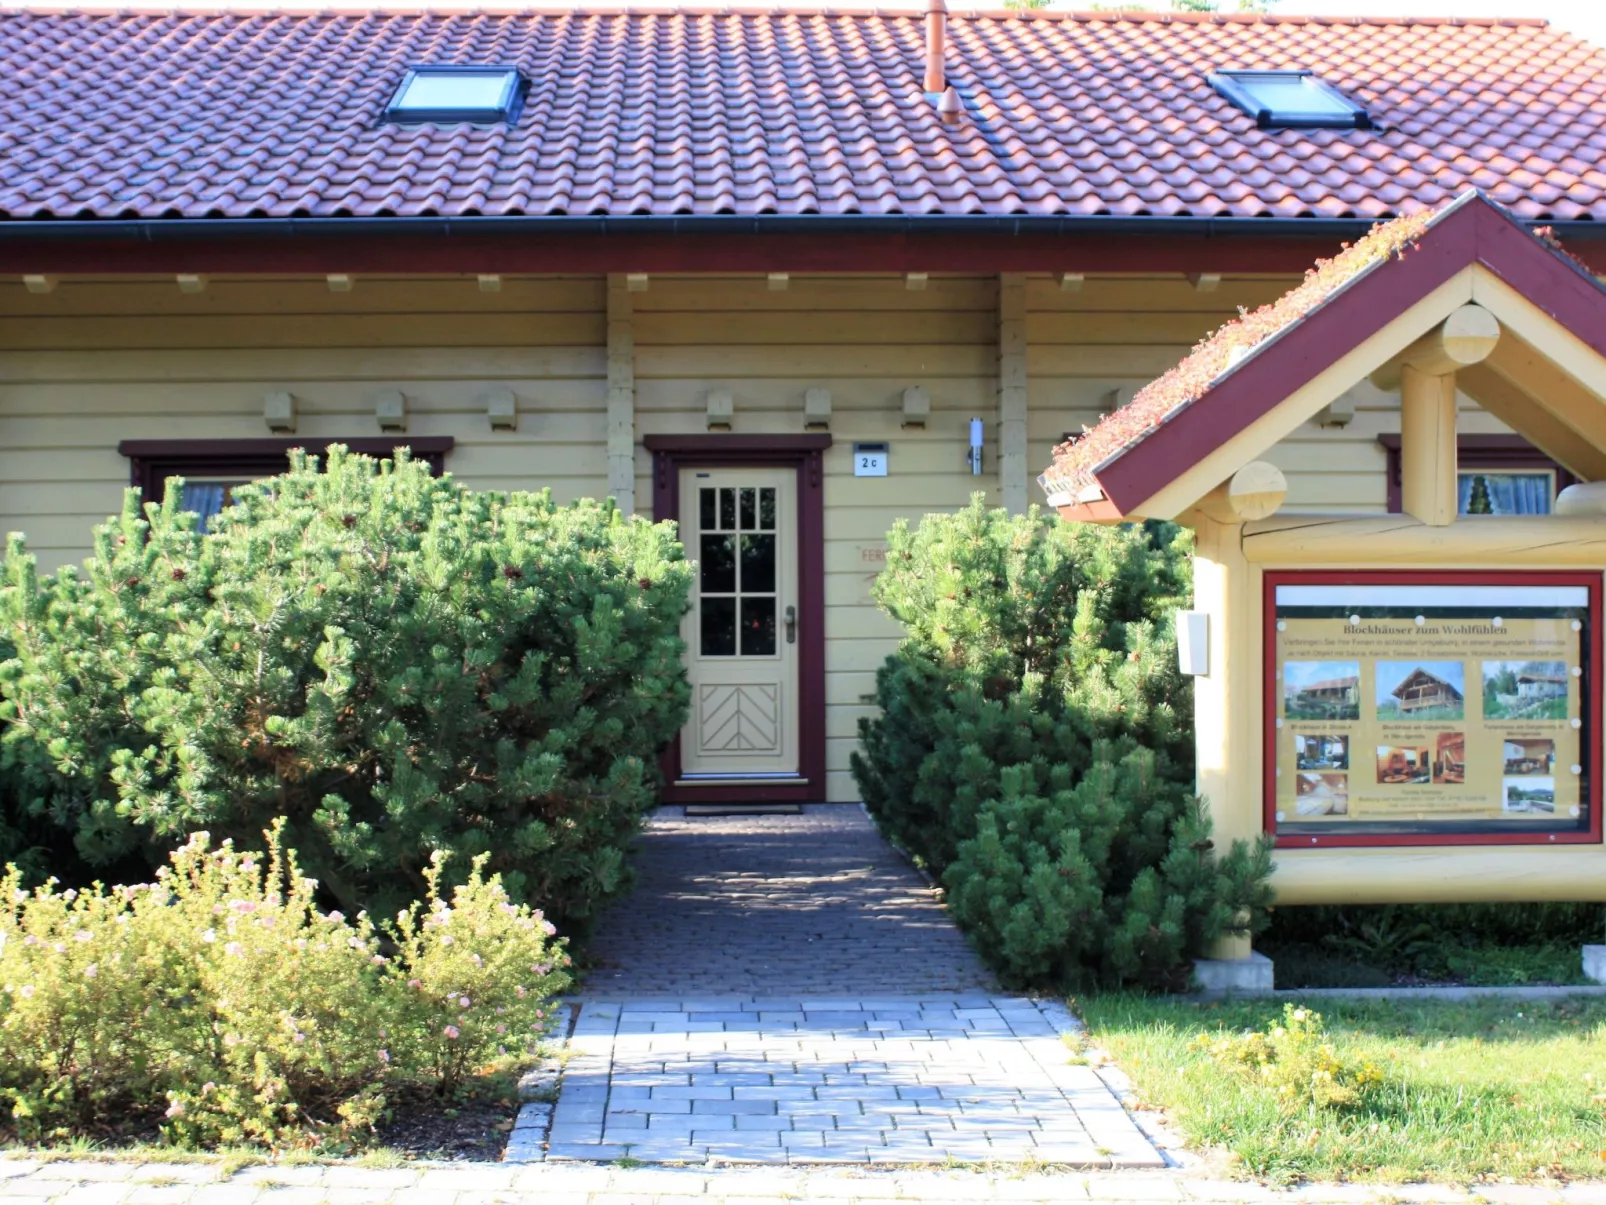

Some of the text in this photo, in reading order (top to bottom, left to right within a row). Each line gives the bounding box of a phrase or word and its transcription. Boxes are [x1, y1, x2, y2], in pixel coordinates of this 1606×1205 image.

[862, 457, 877, 468] 2 c
[1343, 625, 1508, 635] Blockhäuser zum Wohlfühlen
